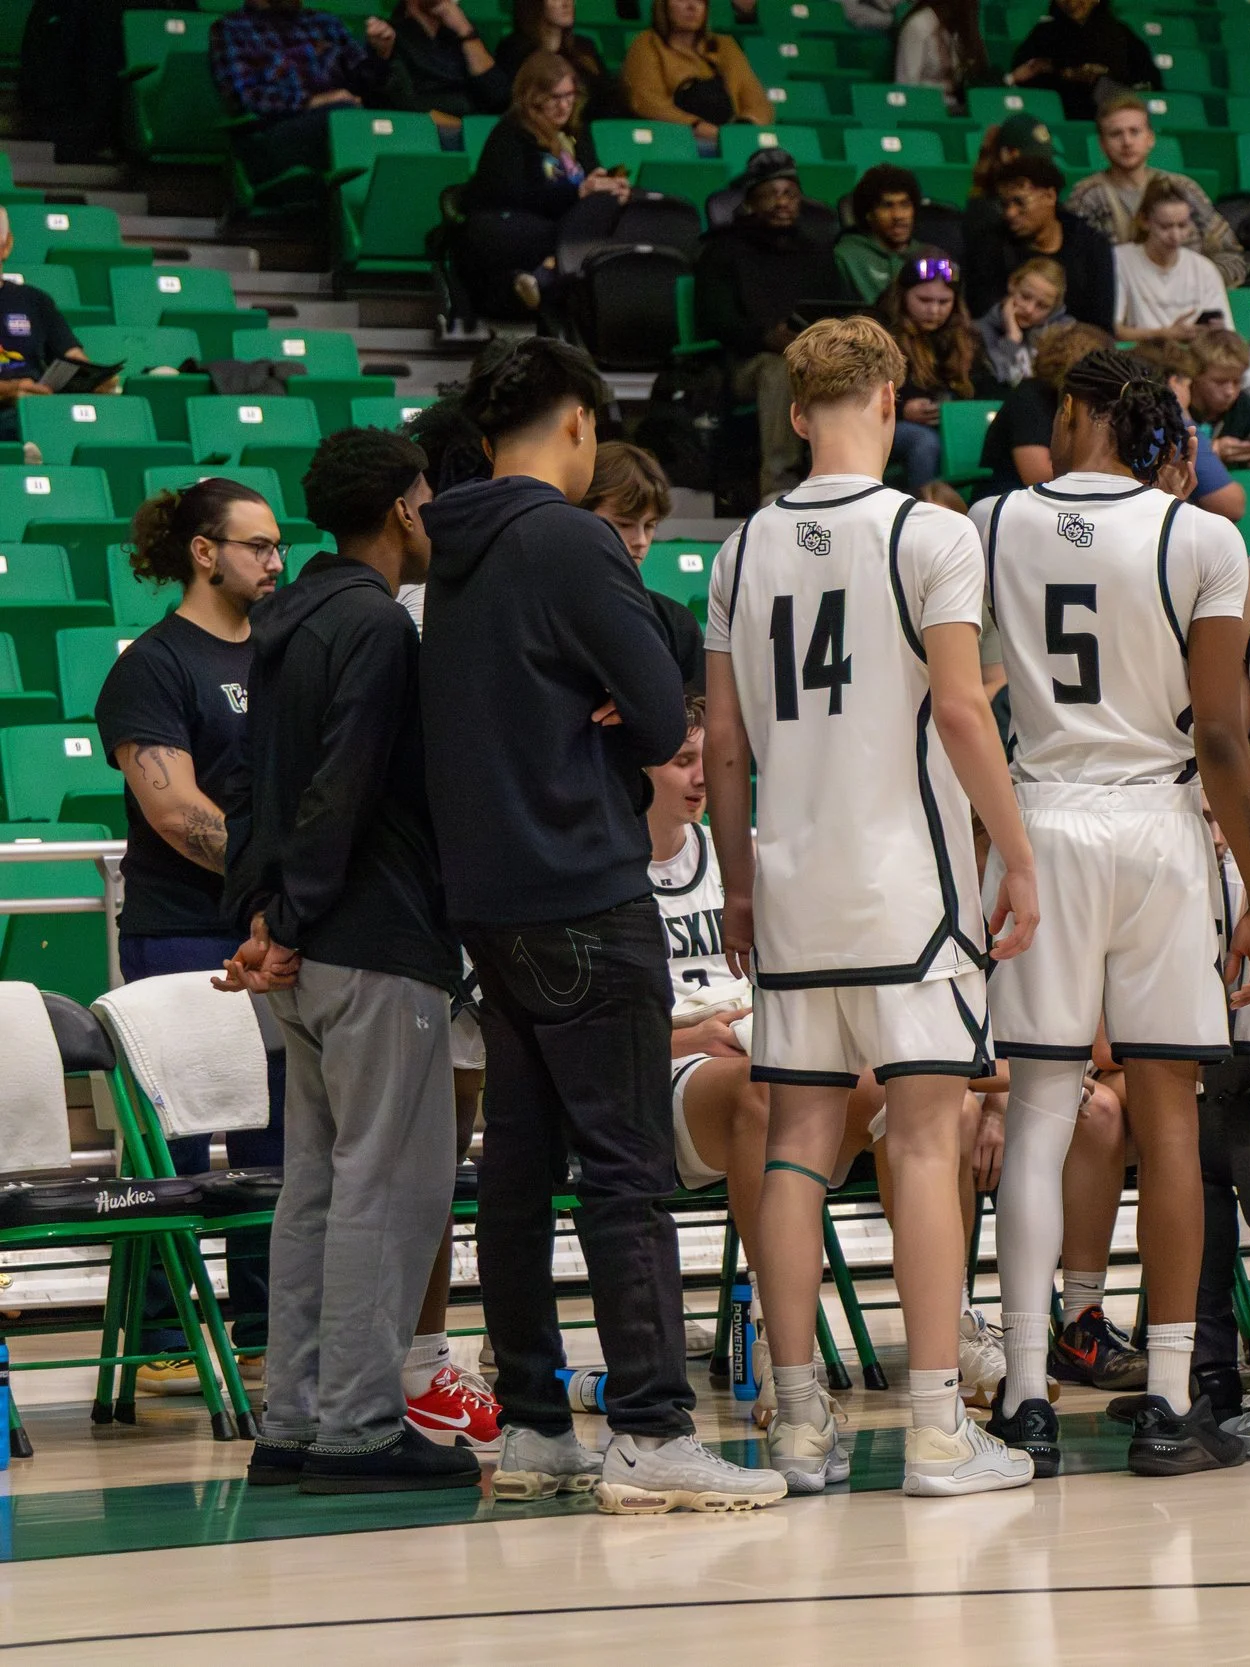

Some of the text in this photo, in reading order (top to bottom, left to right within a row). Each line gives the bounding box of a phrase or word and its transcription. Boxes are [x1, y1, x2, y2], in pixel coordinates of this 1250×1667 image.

[768, 588, 853, 722] 14
[1044, 583, 1102, 705] 5
[94, 1186, 156, 1214] Huskies
[733, 1303, 743, 1382] POWERADE
